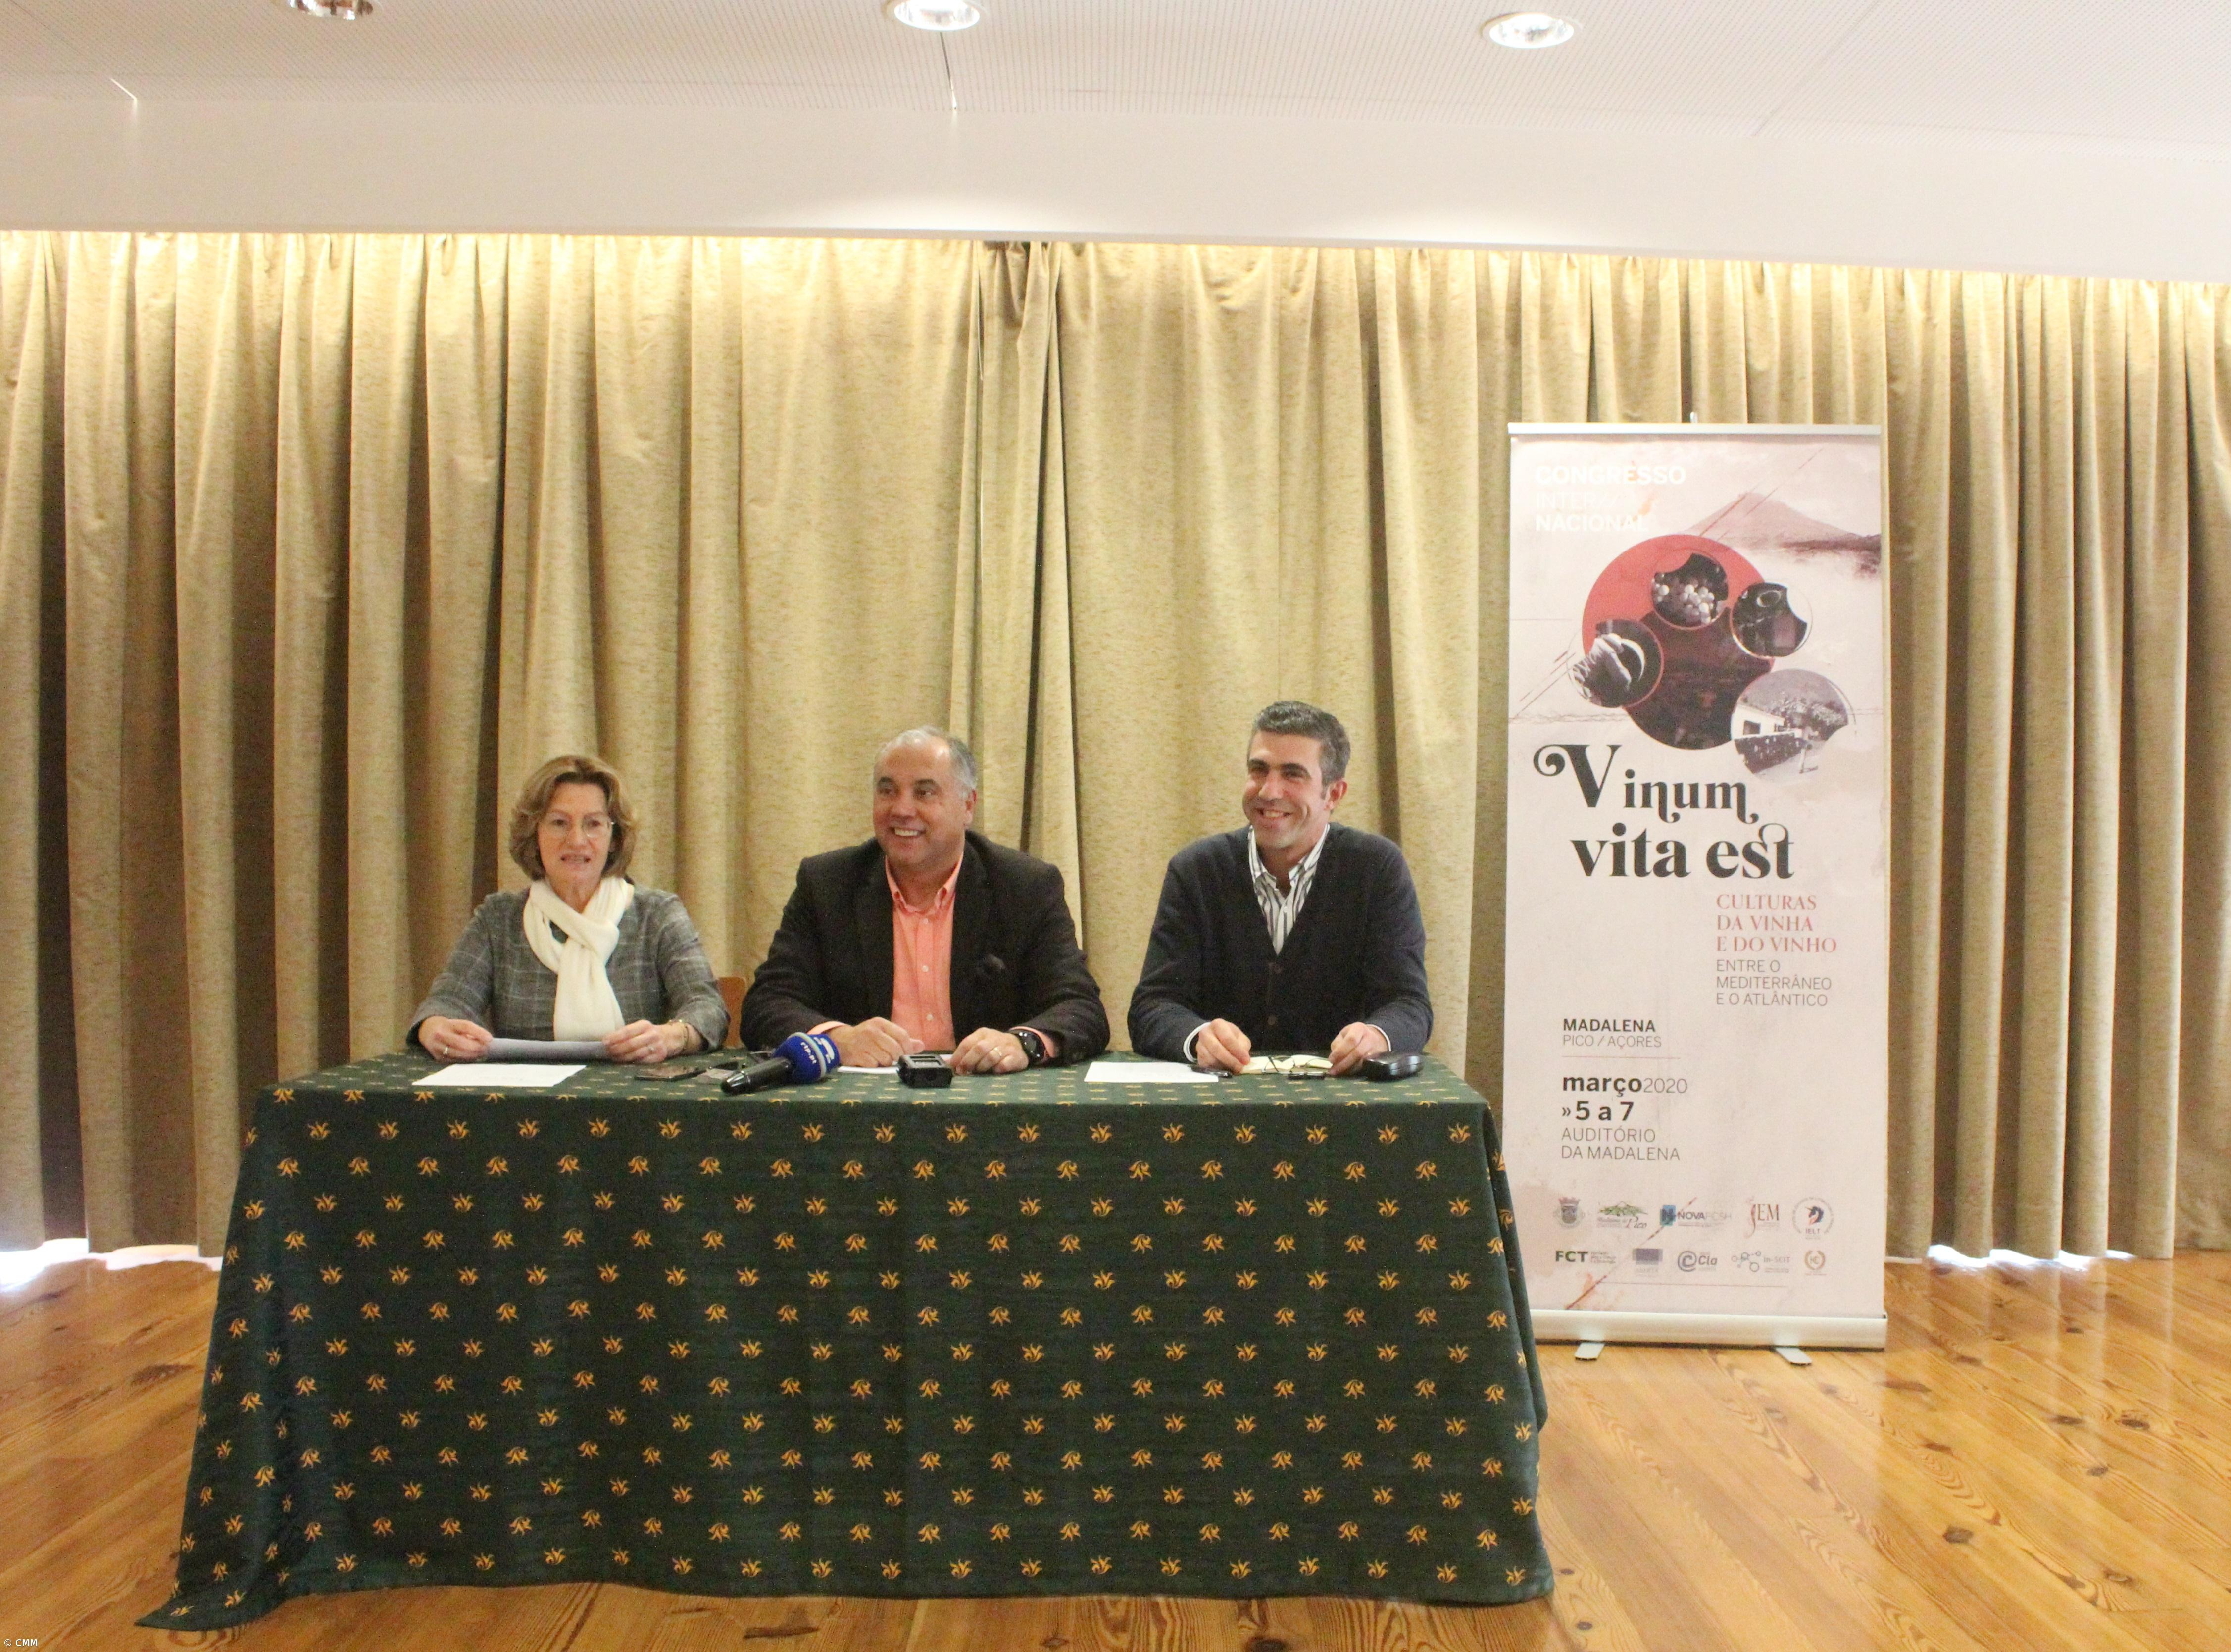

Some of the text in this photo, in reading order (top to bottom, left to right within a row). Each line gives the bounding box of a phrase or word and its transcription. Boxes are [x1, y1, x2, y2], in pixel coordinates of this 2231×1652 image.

[1536, 466, 1686, 485] CONGRESSO
[1536, 514, 1649, 531] NACIONAL
[1533, 744, 1759, 824] Vinum
[1570, 822, 1794, 880] vita est
[1716, 895, 1817, 910] CULTURAS
[1717, 915, 1813, 931] DA VINHA
[1717, 937, 1837, 952] E DO VINHO
[1717, 959, 1781, 973] ENTRE O
[1717, 973, 1832, 990] MEDITERRÂNEO
[1716, 990, 1828, 1006] E O ATLÂNTICO
[1564, 1019, 1656, 1032] MADALENA
[1563, 1035, 1594, 1047] PICO
[1607, 1036, 1662, 1049] AÇORES
[1598, 1106, 1612, 1121] a
[1620, 1101, 1634, 1121] 7
[1562, 1126, 1656, 1142] AUDITÓRIO
[1562, 1145, 1680, 1161] DA MADALENA
[1556, 1251, 1588, 1262] FCT
